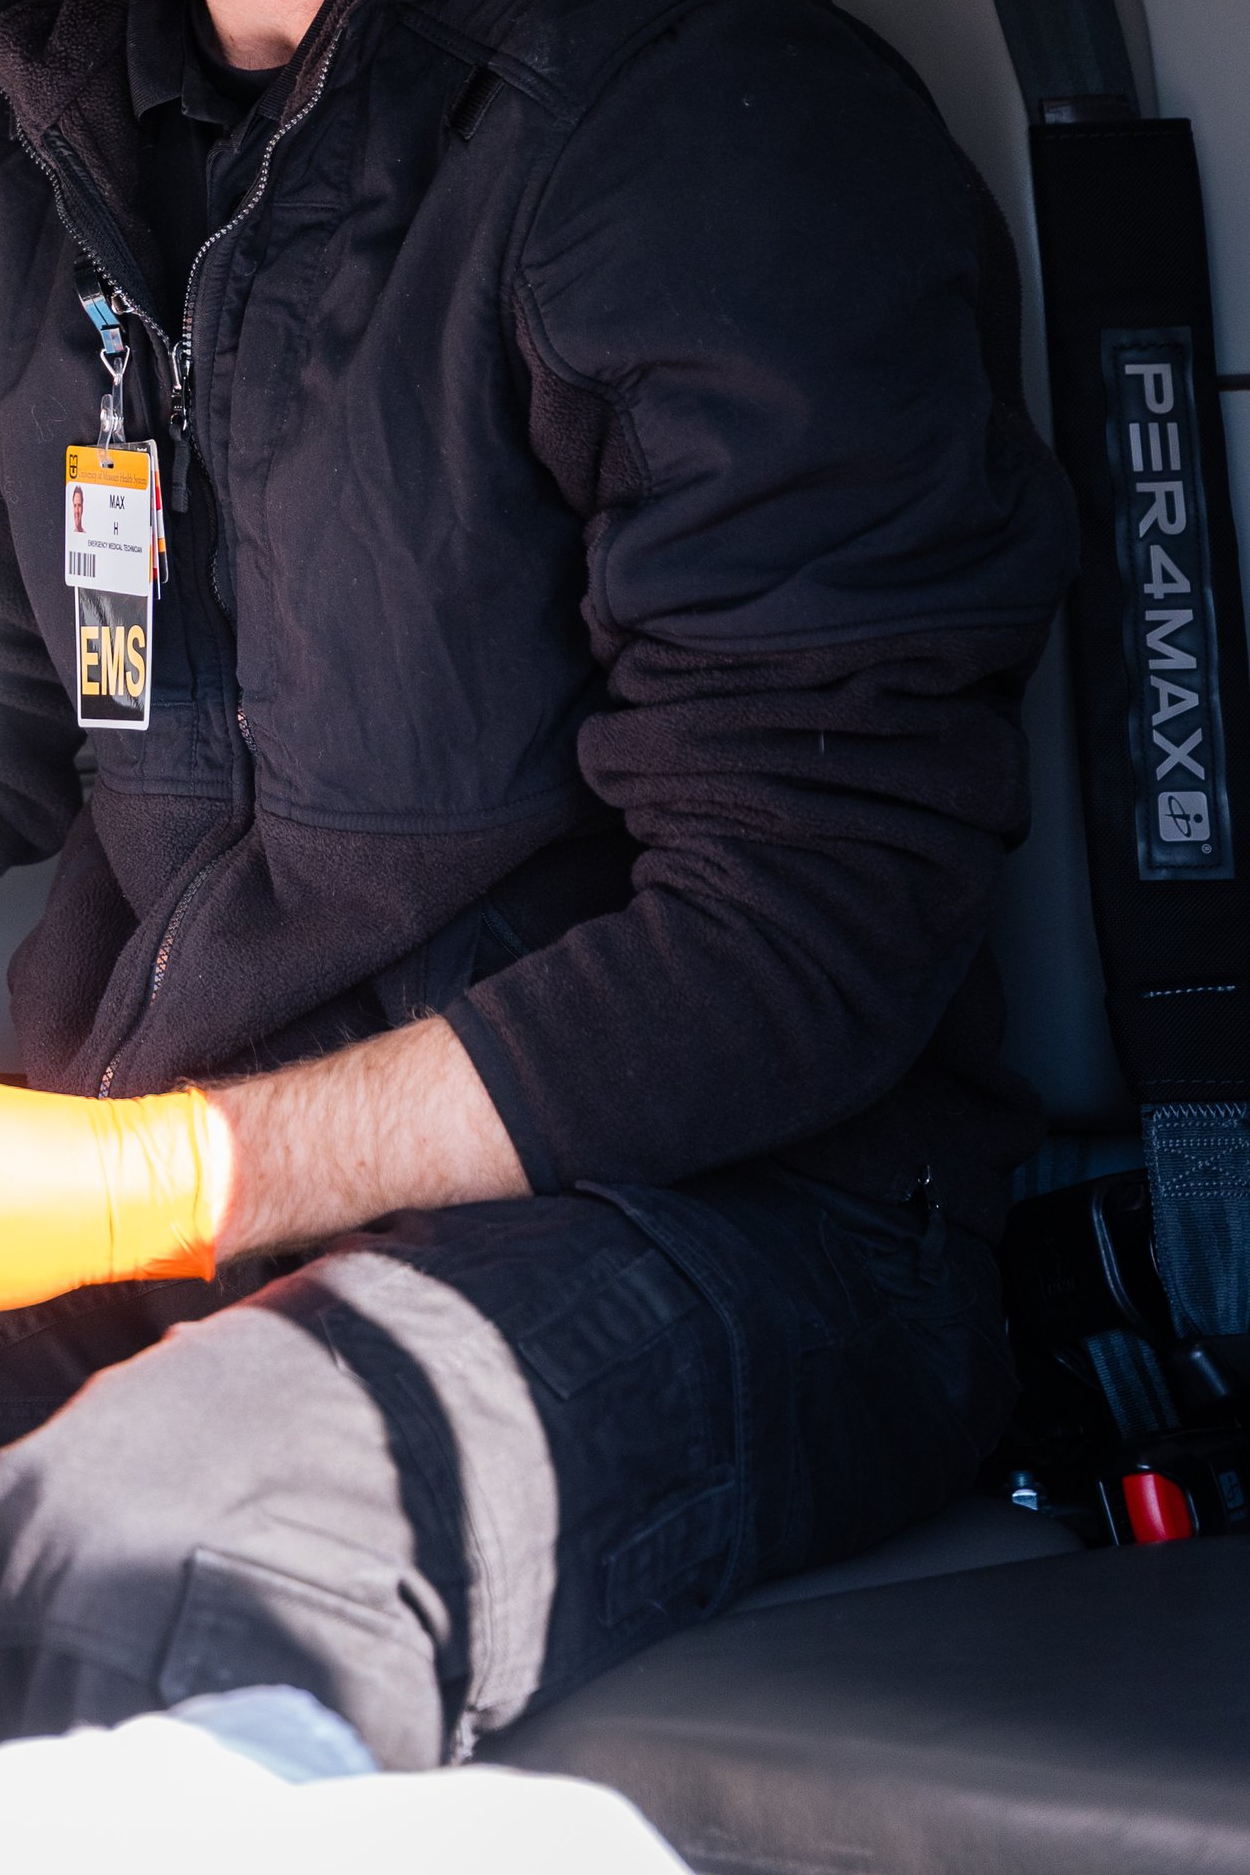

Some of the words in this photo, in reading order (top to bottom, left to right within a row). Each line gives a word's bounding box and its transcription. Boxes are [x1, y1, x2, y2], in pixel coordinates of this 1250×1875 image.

[110, 495, 125, 509] MAX
[113, 522, 118, 535] H
[1125, 363, 1206, 783] PER4MAX
[81, 625, 146, 697] EMS
